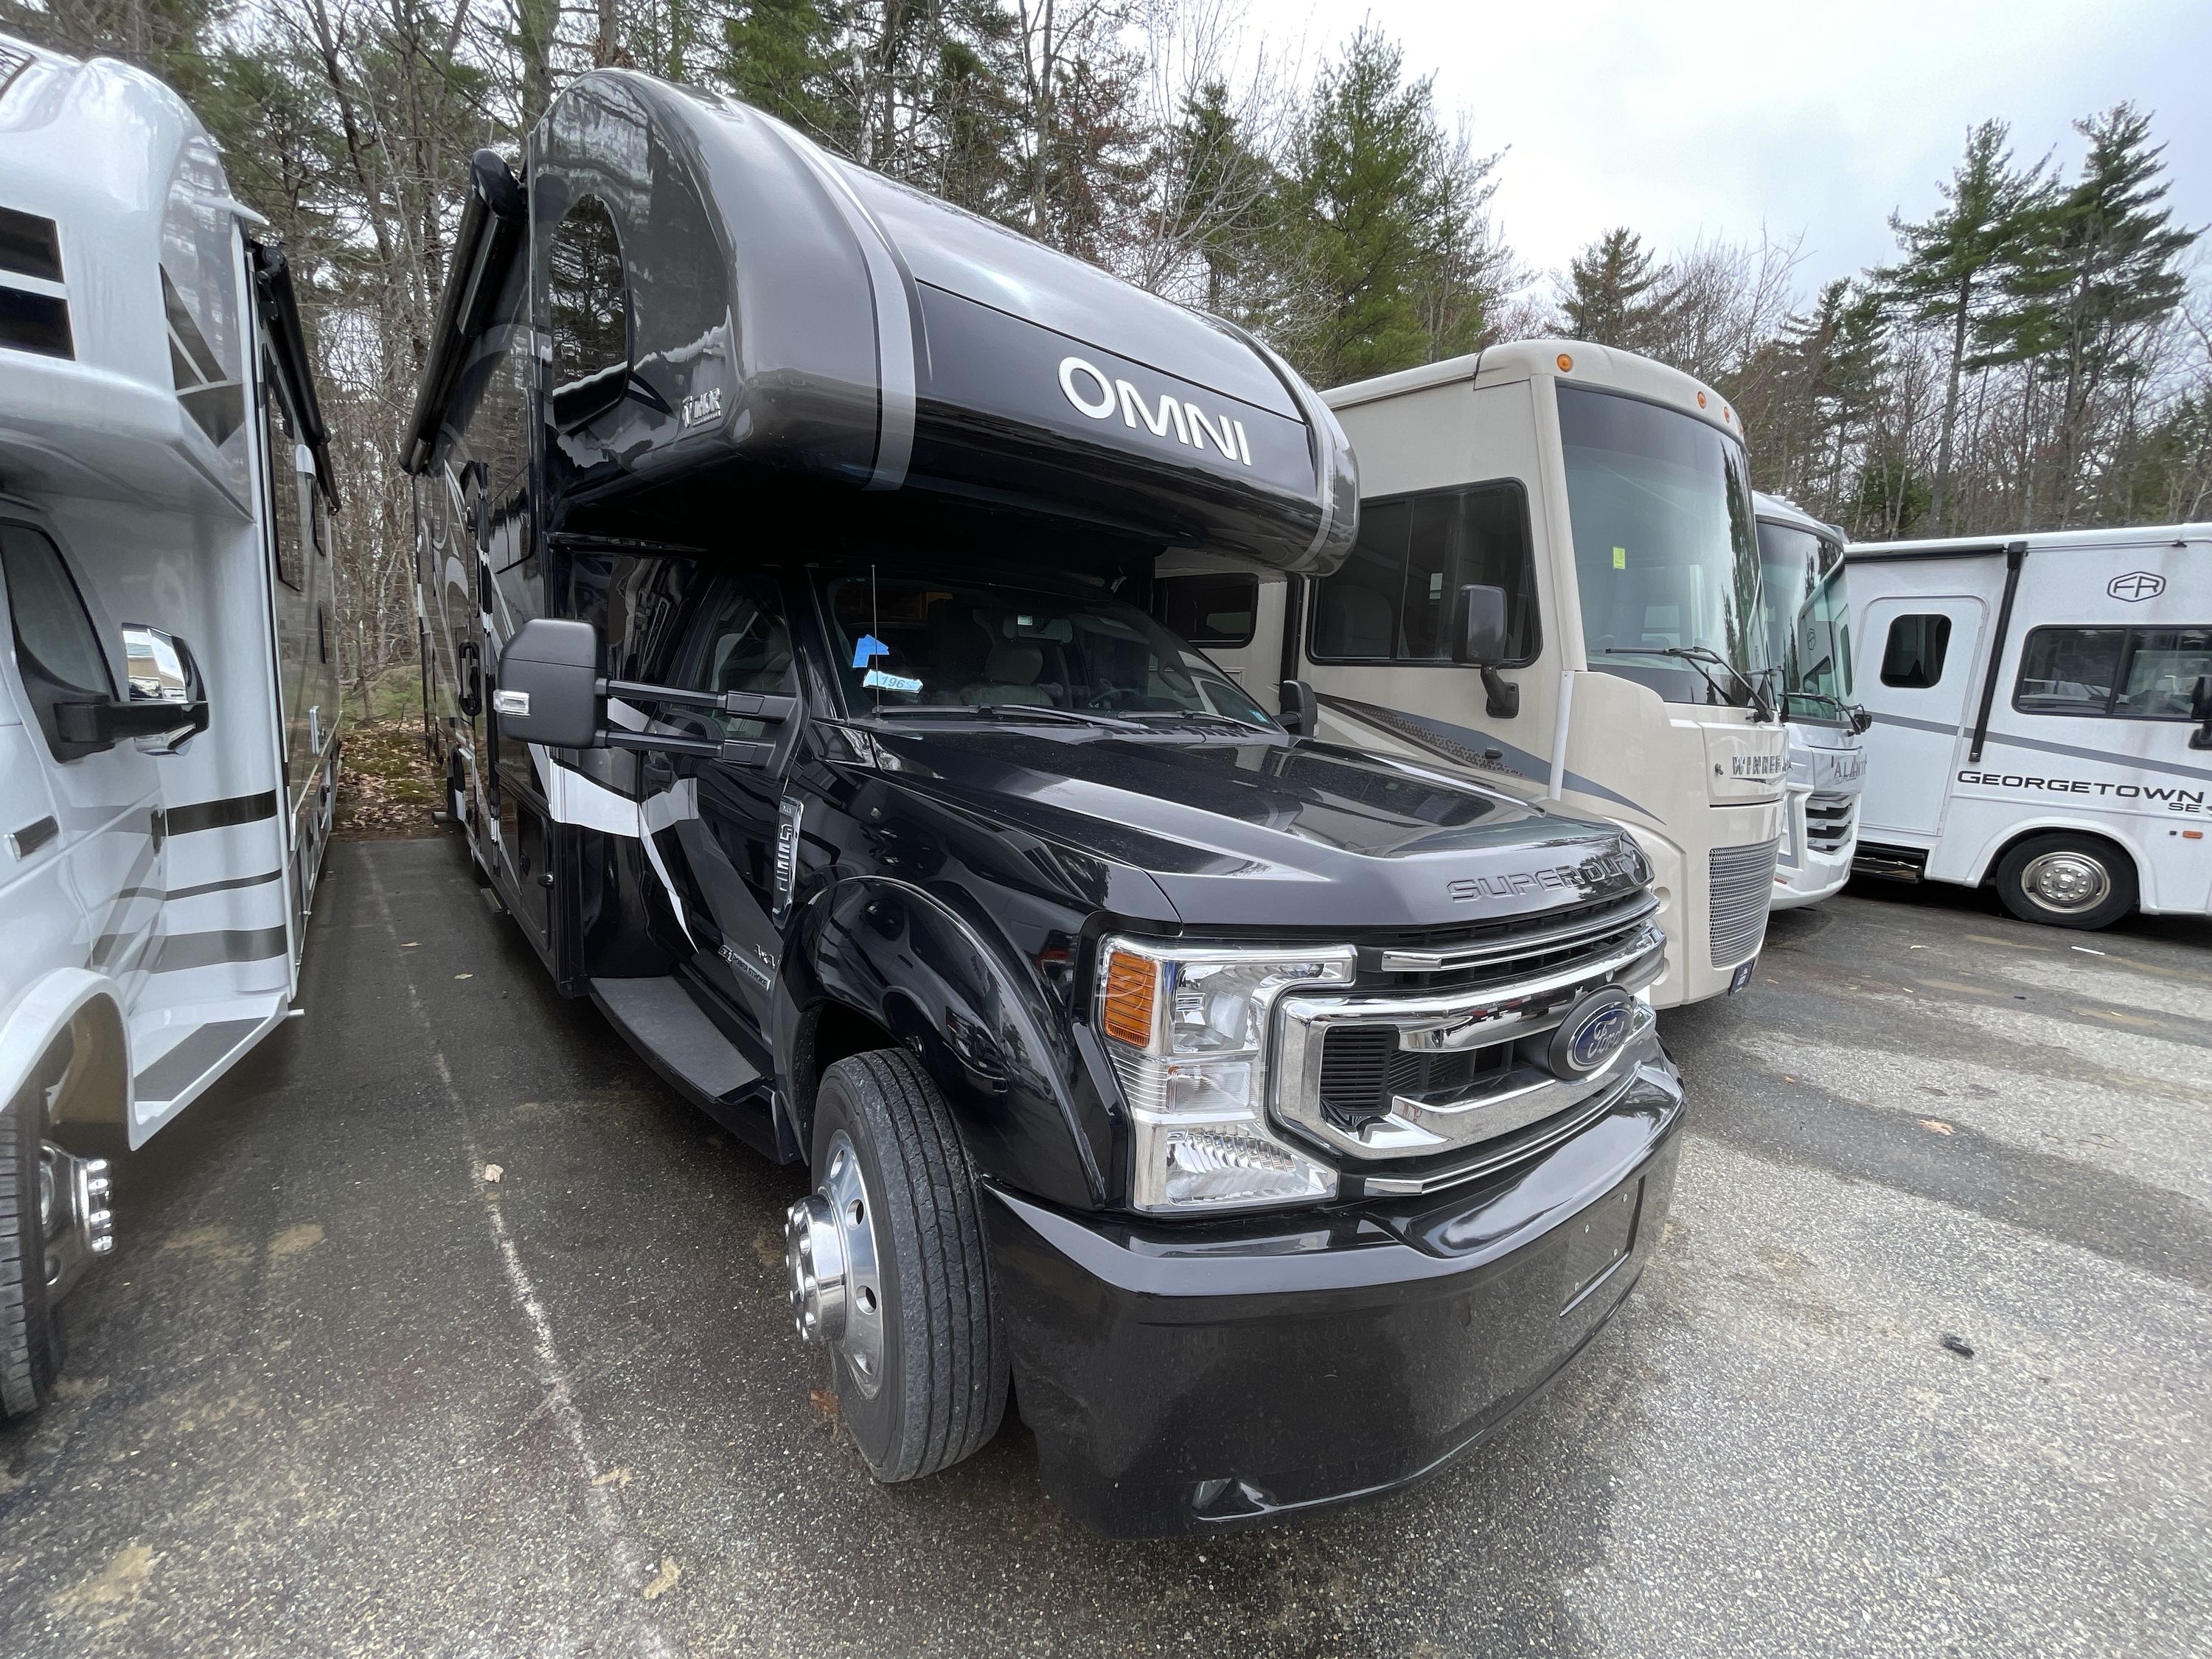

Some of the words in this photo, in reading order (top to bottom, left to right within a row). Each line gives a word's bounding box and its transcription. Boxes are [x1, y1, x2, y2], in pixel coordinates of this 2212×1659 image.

[1057, 356, 1252, 467] OMNI
[1958, 770, 2205, 804] GEORGETOWN
[2167, 801, 2202, 813] SE
[1447, 864, 1585, 903] SUPER
[1585, 849, 1641, 883] DUTY
[1587, 1017, 1625, 1059] Ford
